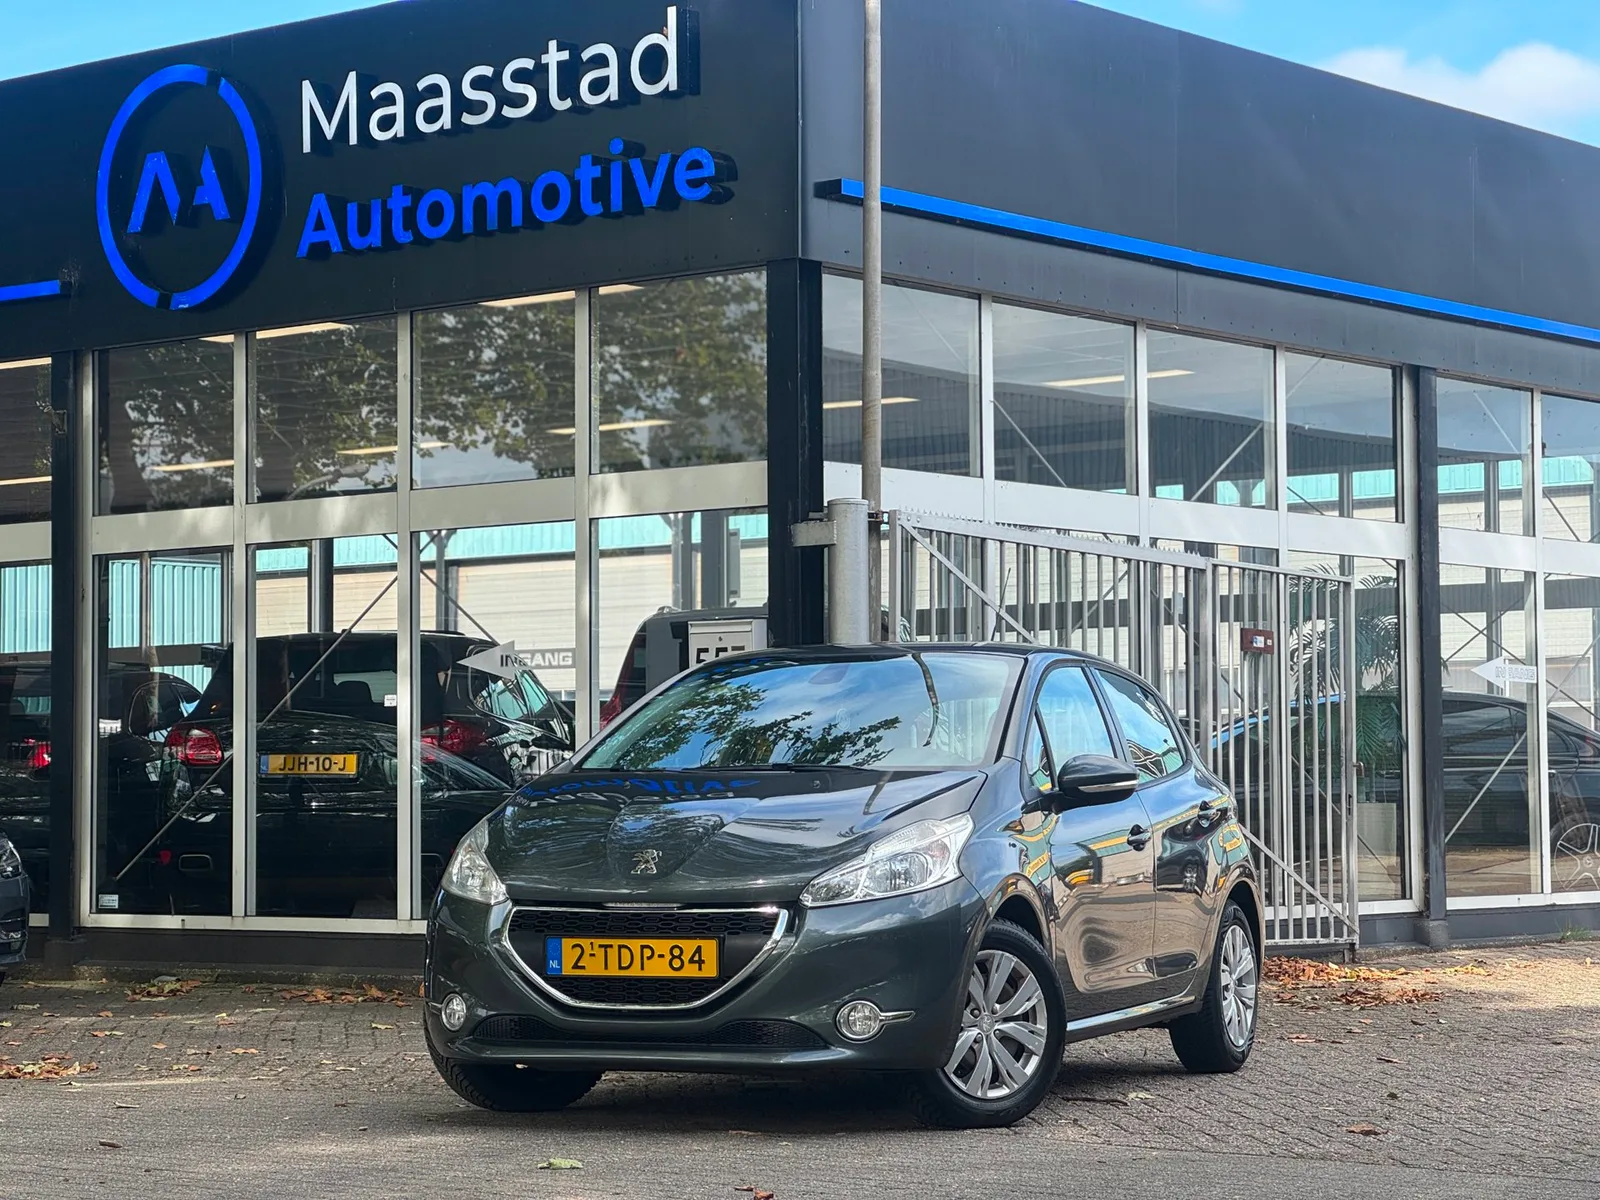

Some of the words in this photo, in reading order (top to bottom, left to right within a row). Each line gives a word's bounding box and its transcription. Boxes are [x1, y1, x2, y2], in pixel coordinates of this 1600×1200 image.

[302, 5, 678, 153] Maasstad
[296, 137, 716, 258] Automotive
[278, 756, 347, 772] JJH-10-J
[549, 959, 560, 969] NL
